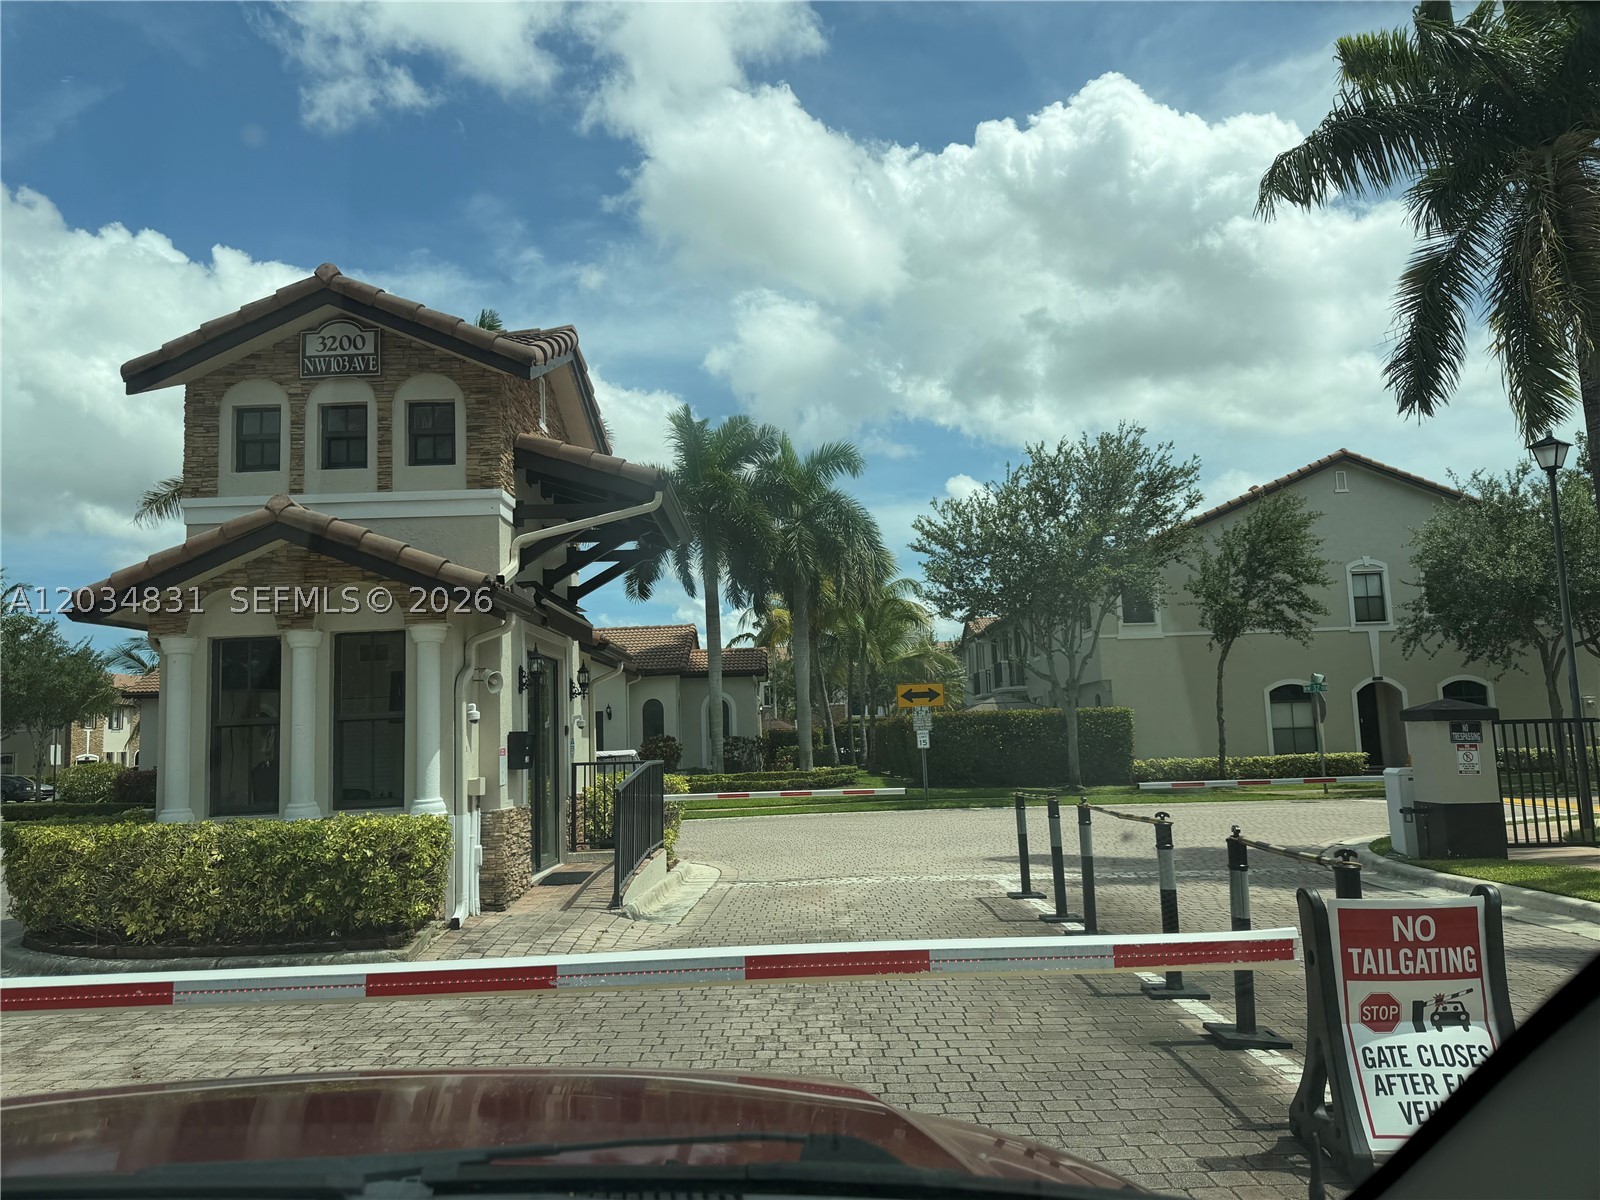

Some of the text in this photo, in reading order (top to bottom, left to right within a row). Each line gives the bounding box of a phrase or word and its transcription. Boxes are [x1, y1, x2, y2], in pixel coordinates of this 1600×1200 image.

[315, 334, 366, 353] 3200
[303, 355, 378, 374] NW 103 AVE
[1392, 914, 1436, 942] NO
[1347, 945, 1477, 975] TAILGATING
[1362, 1005, 1399, 1021] STOP
[1361, 1044, 1489, 1069] GATE CLOSES
[1374, 1073, 1440, 1097] AFTER
